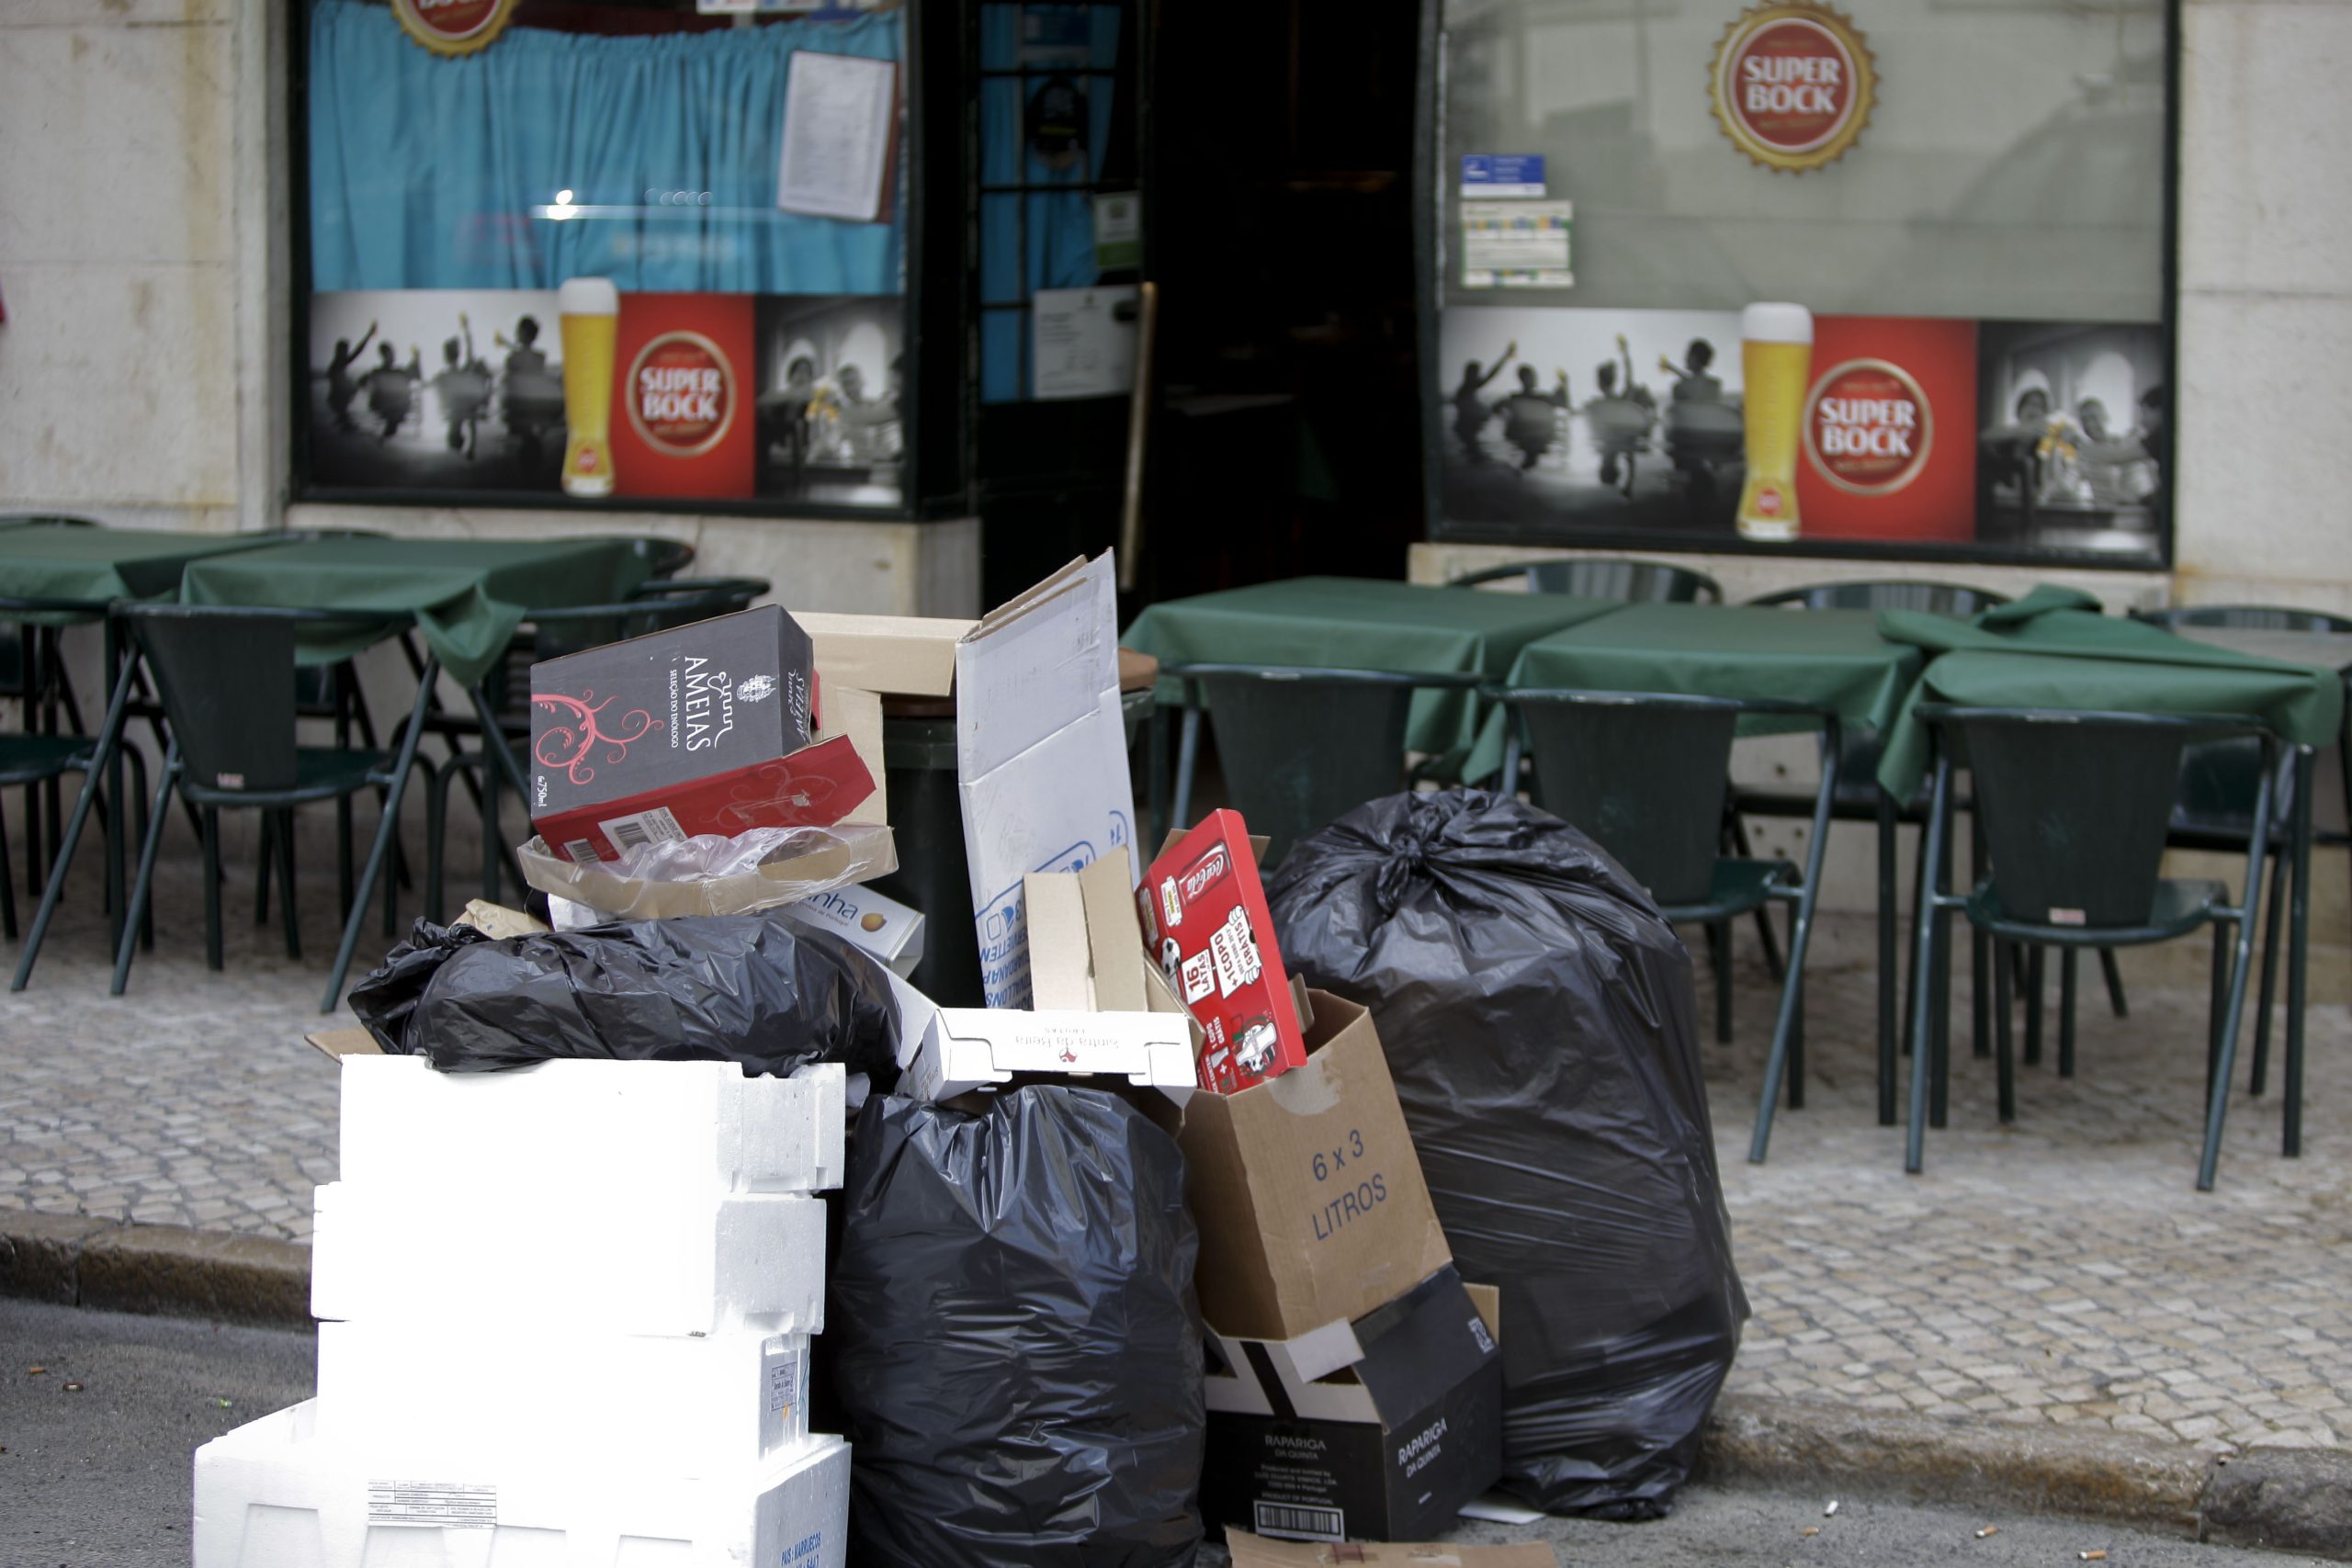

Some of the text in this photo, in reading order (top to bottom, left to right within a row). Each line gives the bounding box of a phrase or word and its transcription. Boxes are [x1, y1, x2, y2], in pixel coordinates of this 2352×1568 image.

[1742, 55, 1841, 85] SUPER
[1746, 83, 1837, 114] BOCK
[639, 367, 722, 394] SUPER
[642, 393, 720, 422] BOCK
[1819, 396, 1917, 428] SUPER
[1822, 425, 1912, 457] BOCK
[671, 700, 679, 712] DO
[684, 656, 711, 752] AMEIAS
[1235, 921, 1254, 966] GRÁTIS
[1186, 966, 1201, 993] 16
[1197, 953, 1210, 993] LATAS
[1312, 1129, 1365, 1182] 6 x 3
[1311, 1173, 1388, 1242] LITROS
[1265, 1435, 1327, 1450] RAPARIGA
[1275, 1450, 1287, 1458] DA
[1397, 1417, 1448, 1467] RAPARIGA
[1406, 1464, 1418, 1479] DA
